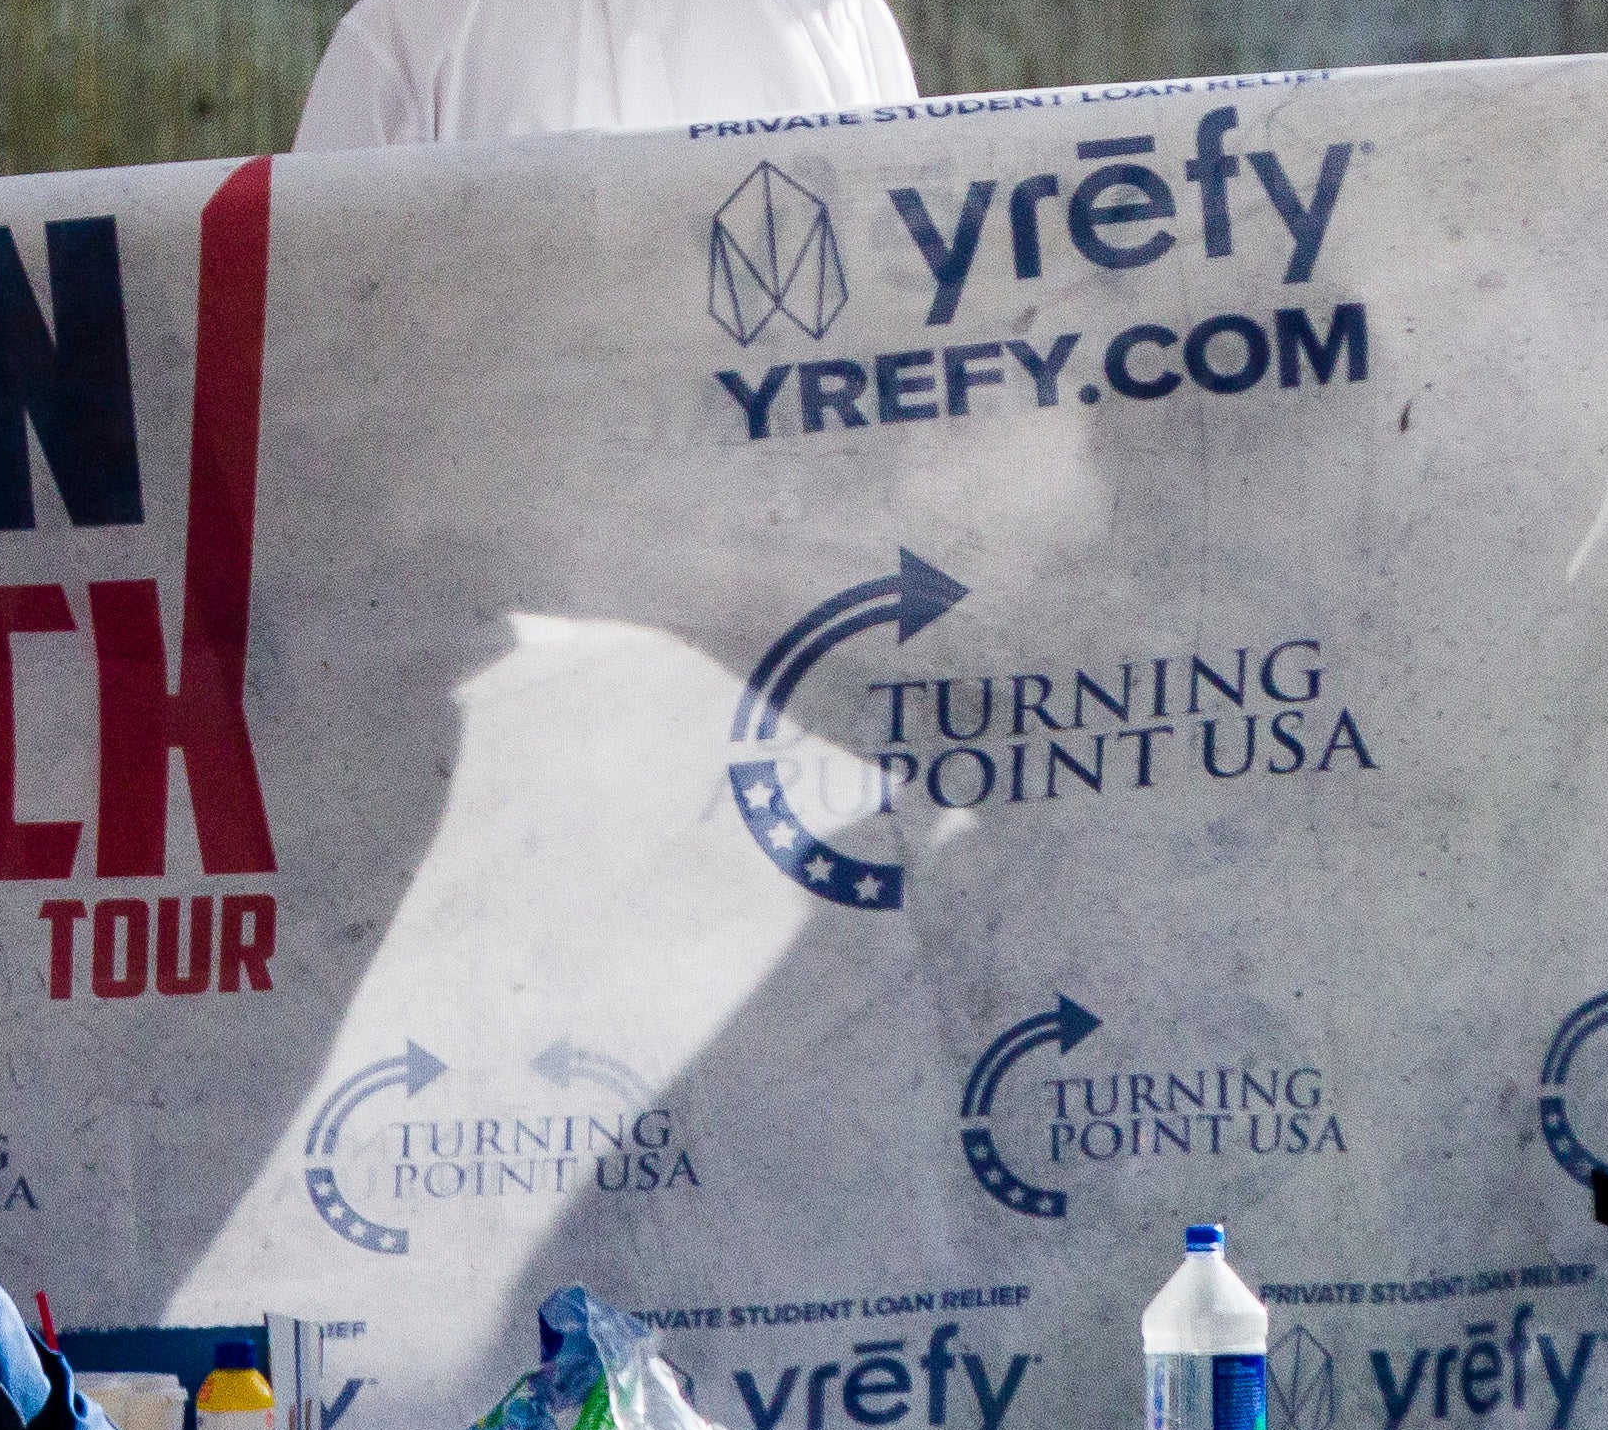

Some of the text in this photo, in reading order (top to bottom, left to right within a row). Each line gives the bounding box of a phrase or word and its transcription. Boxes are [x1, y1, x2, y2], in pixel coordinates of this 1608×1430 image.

[689, 106, 859, 138] PRIVATE
[873, 92, 1062, 123] STUDENT
[715, 302, 1369, 441] YREFY.COM
[869, 639, 1325, 747] TURNING
[877, 706, 1381, 817] POINT USA
[39, 894, 277, 1002] TOUR
[1042, 1066, 1324, 1116] TURNING
[390, 1107, 672, 1160] TURNING
[1046, 1110, 1350, 1166] POINT USA
[389, 1142, 701, 1200] POINT USA
[632, 1284, 1031, 1334] RIVATE STUDENT LOAN RELIEF
[1259, 1282, 1367, 1305] PRIVATE
[1368, 1272, 1465, 1303] STUDENT
